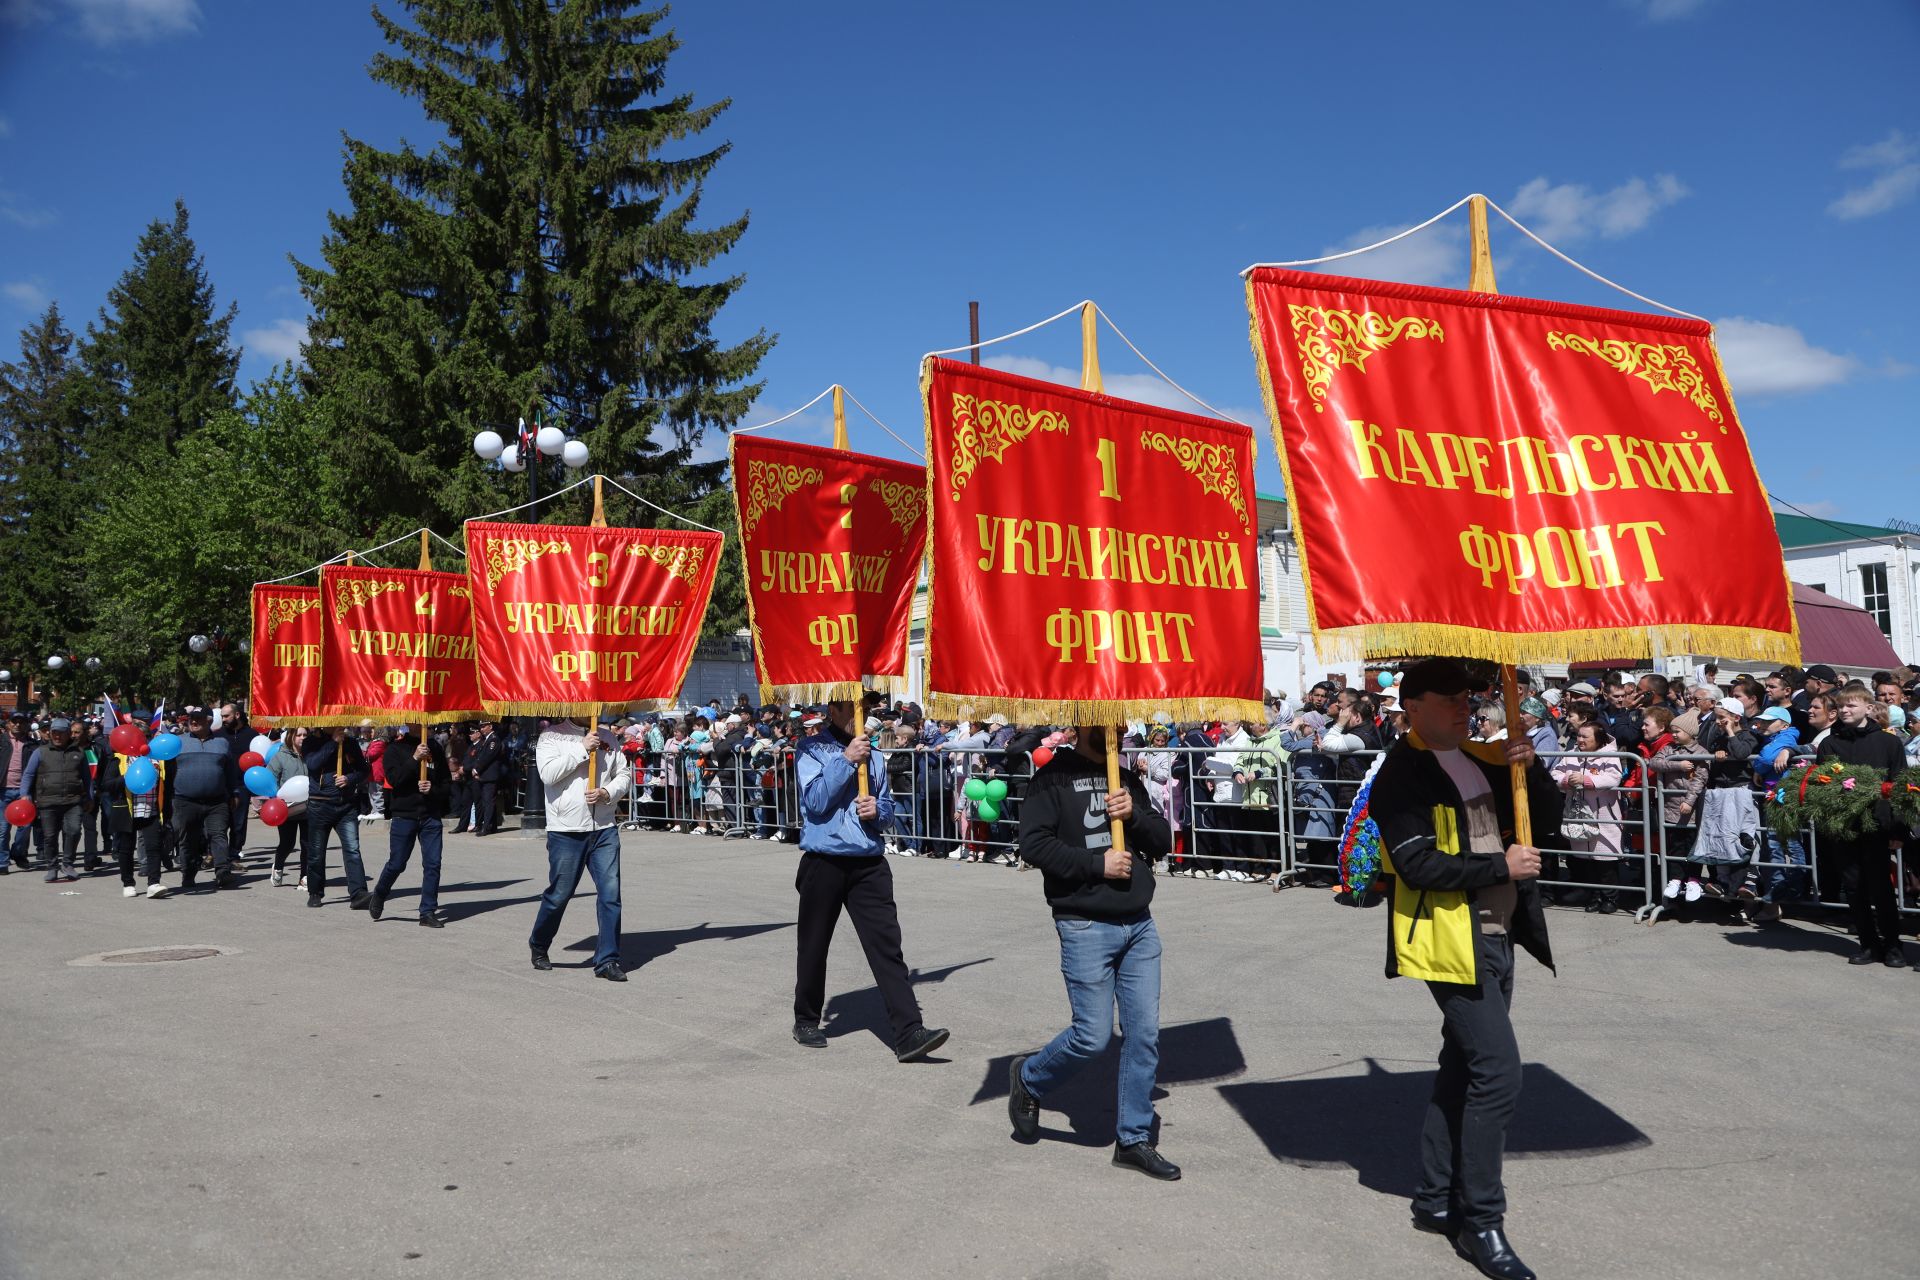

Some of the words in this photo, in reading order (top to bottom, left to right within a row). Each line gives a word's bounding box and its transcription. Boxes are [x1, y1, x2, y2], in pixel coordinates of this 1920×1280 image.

[1096, 438, 1122, 502] 1
[1345, 419, 1733, 500] КАРЕЛЬСКИЙ
[587, 552, 609, 588] 3
[976, 513, 1248, 591] УКРАИНСКИЙ
[1459, 521, 1667, 595] ФРОНТ
[415, 591, 436, 620] 4
[504, 600, 685, 636] УКРАИНСКИЙ
[1046, 607, 1195, 664] ФРОНТ
[552, 650, 640, 682] ФРОНТ
